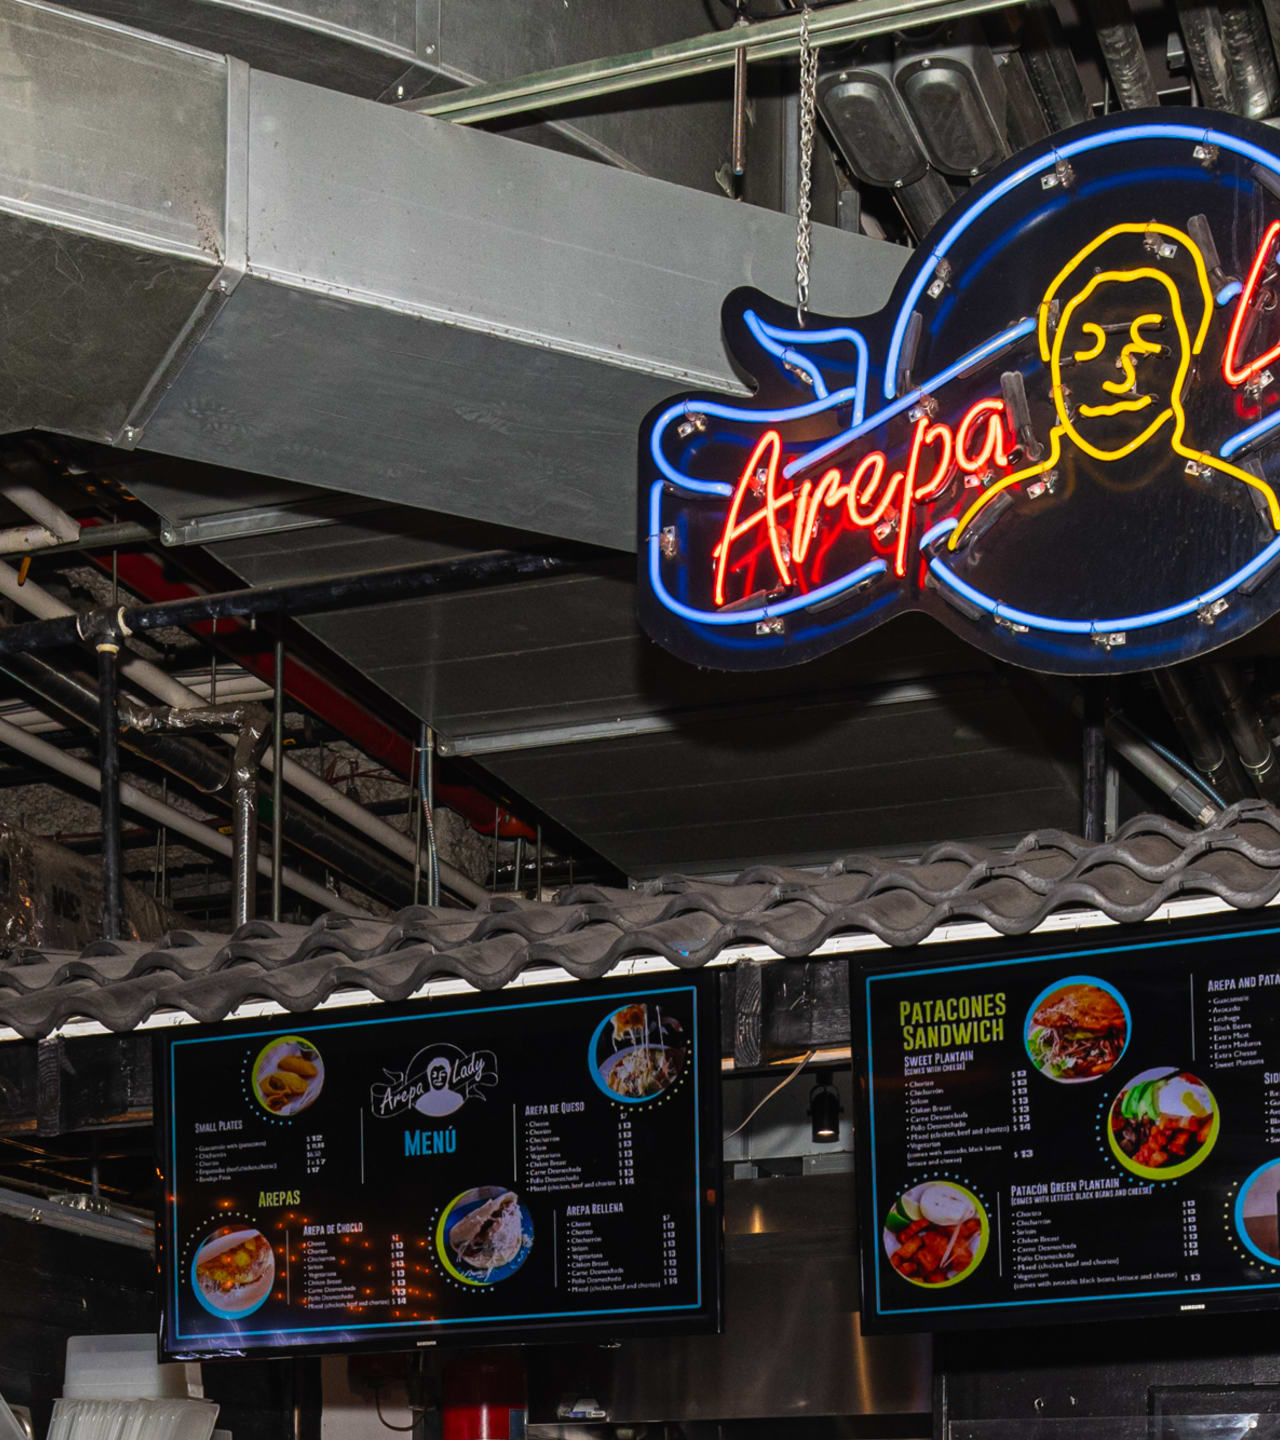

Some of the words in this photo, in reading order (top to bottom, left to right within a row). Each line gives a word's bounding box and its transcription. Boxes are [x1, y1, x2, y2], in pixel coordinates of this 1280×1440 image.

[713, 399, 1009, 605] Arepa
[1208, 979, 1236, 992] AREPA
[1238, 976, 1256, 989] AND
[900, 992, 1006, 1026] PATACONES
[903, 1018, 1004, 1051] SANDWICH
[904, 1053, 932, 1068] SWEET
[934, 1050, 974, 1065] PLANTAIN
[926, 1064, 942, 1074] WITH
[380, 1082, 425, 1115] Arepa
[452, 1052, 486, 1083] Lady
[525, 1104, 548, 1116] AREPA
[550, 1103, 559, 1114] DE
[561, 1101, 585, 1114] QUESO
[195, 1121, 217, 1134] SMALL
[218, 1119, 243, 1132] PLATES
[404, 1125, 457, 1157] MENÚ
[1010, 1182, 1048, 1197] PATACÓN
[1050, 1180, 1077, 1193] GREEN
[1079, 1177, 1120, 1191] PLANTAIN
[258, 1189, 301, 1208] AREPAS
[566, 1204, 590, 1217] AREPA
[591, 1202, 624, 1215] RELLENA
[303, 1224, 325, 1237] AREPA
